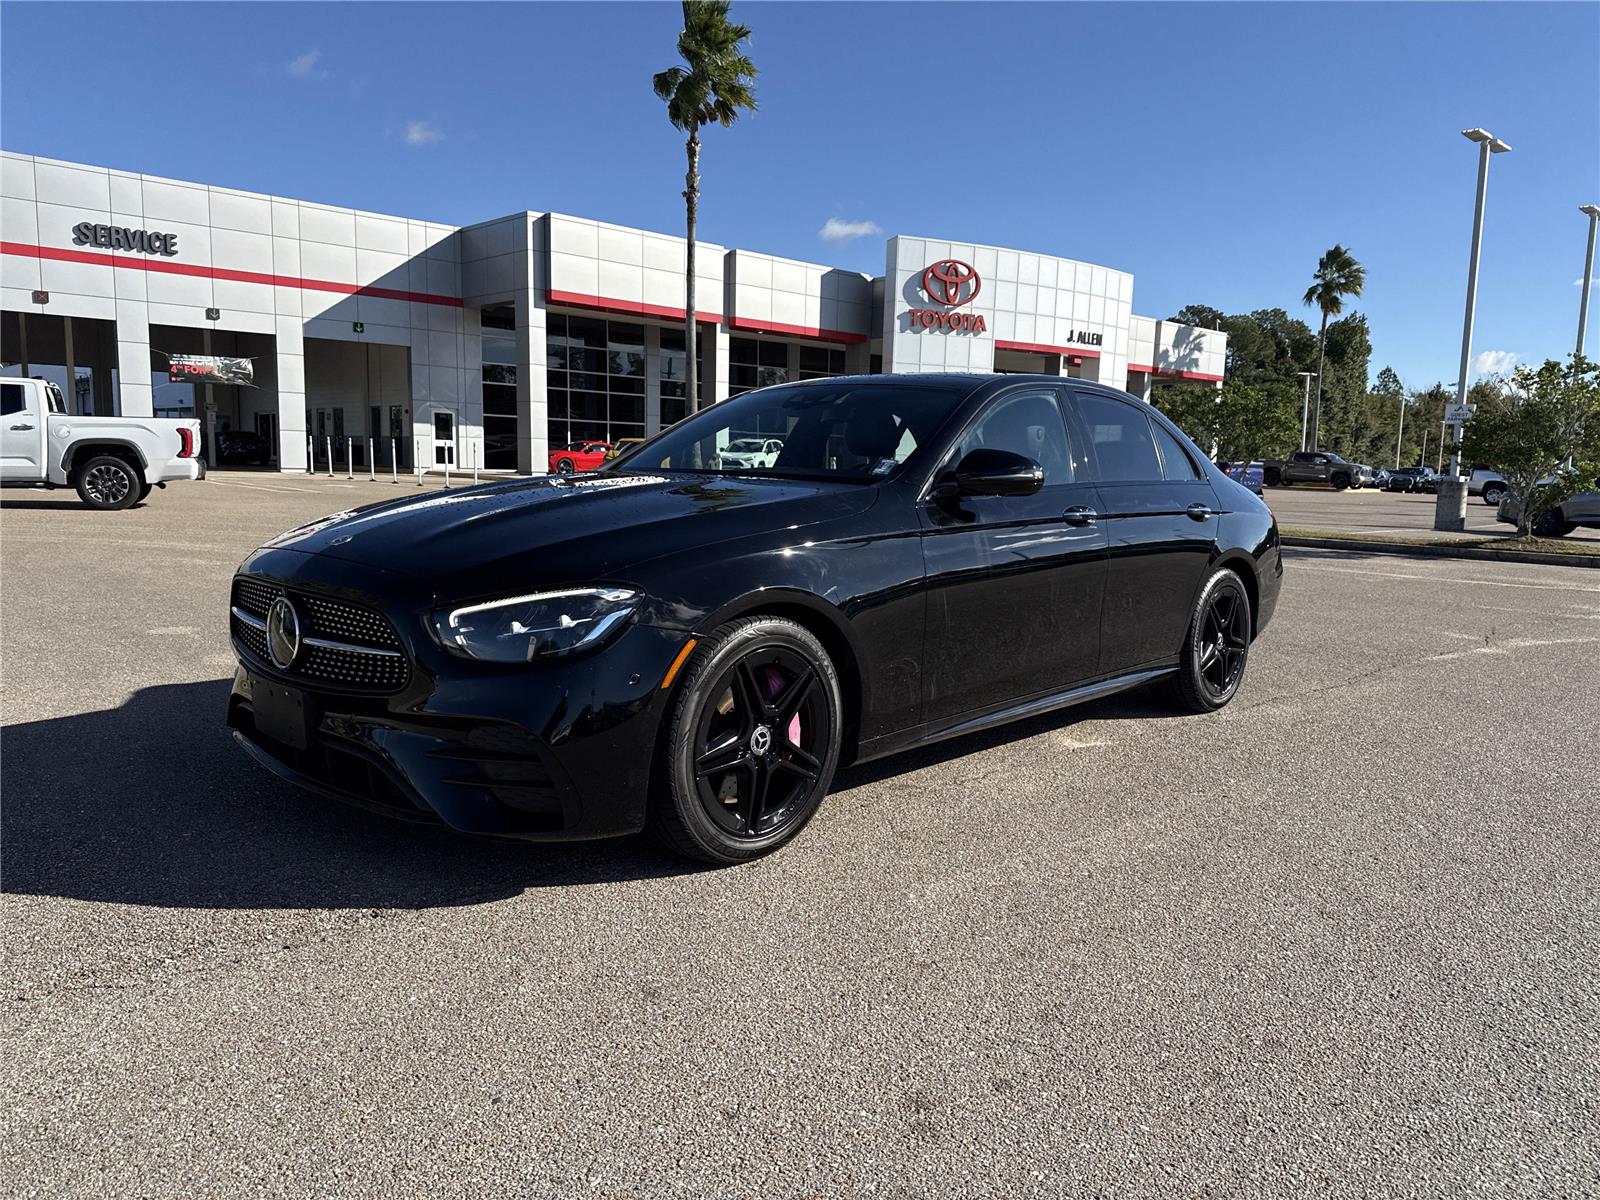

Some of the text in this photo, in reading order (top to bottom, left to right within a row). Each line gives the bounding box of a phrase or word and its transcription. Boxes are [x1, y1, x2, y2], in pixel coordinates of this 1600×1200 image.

[72, 222, 178, 257] SERVICE
[909, 309, 987, 332] TOYOTA
[1067, 329, 1102, 346] J. ALLEN
